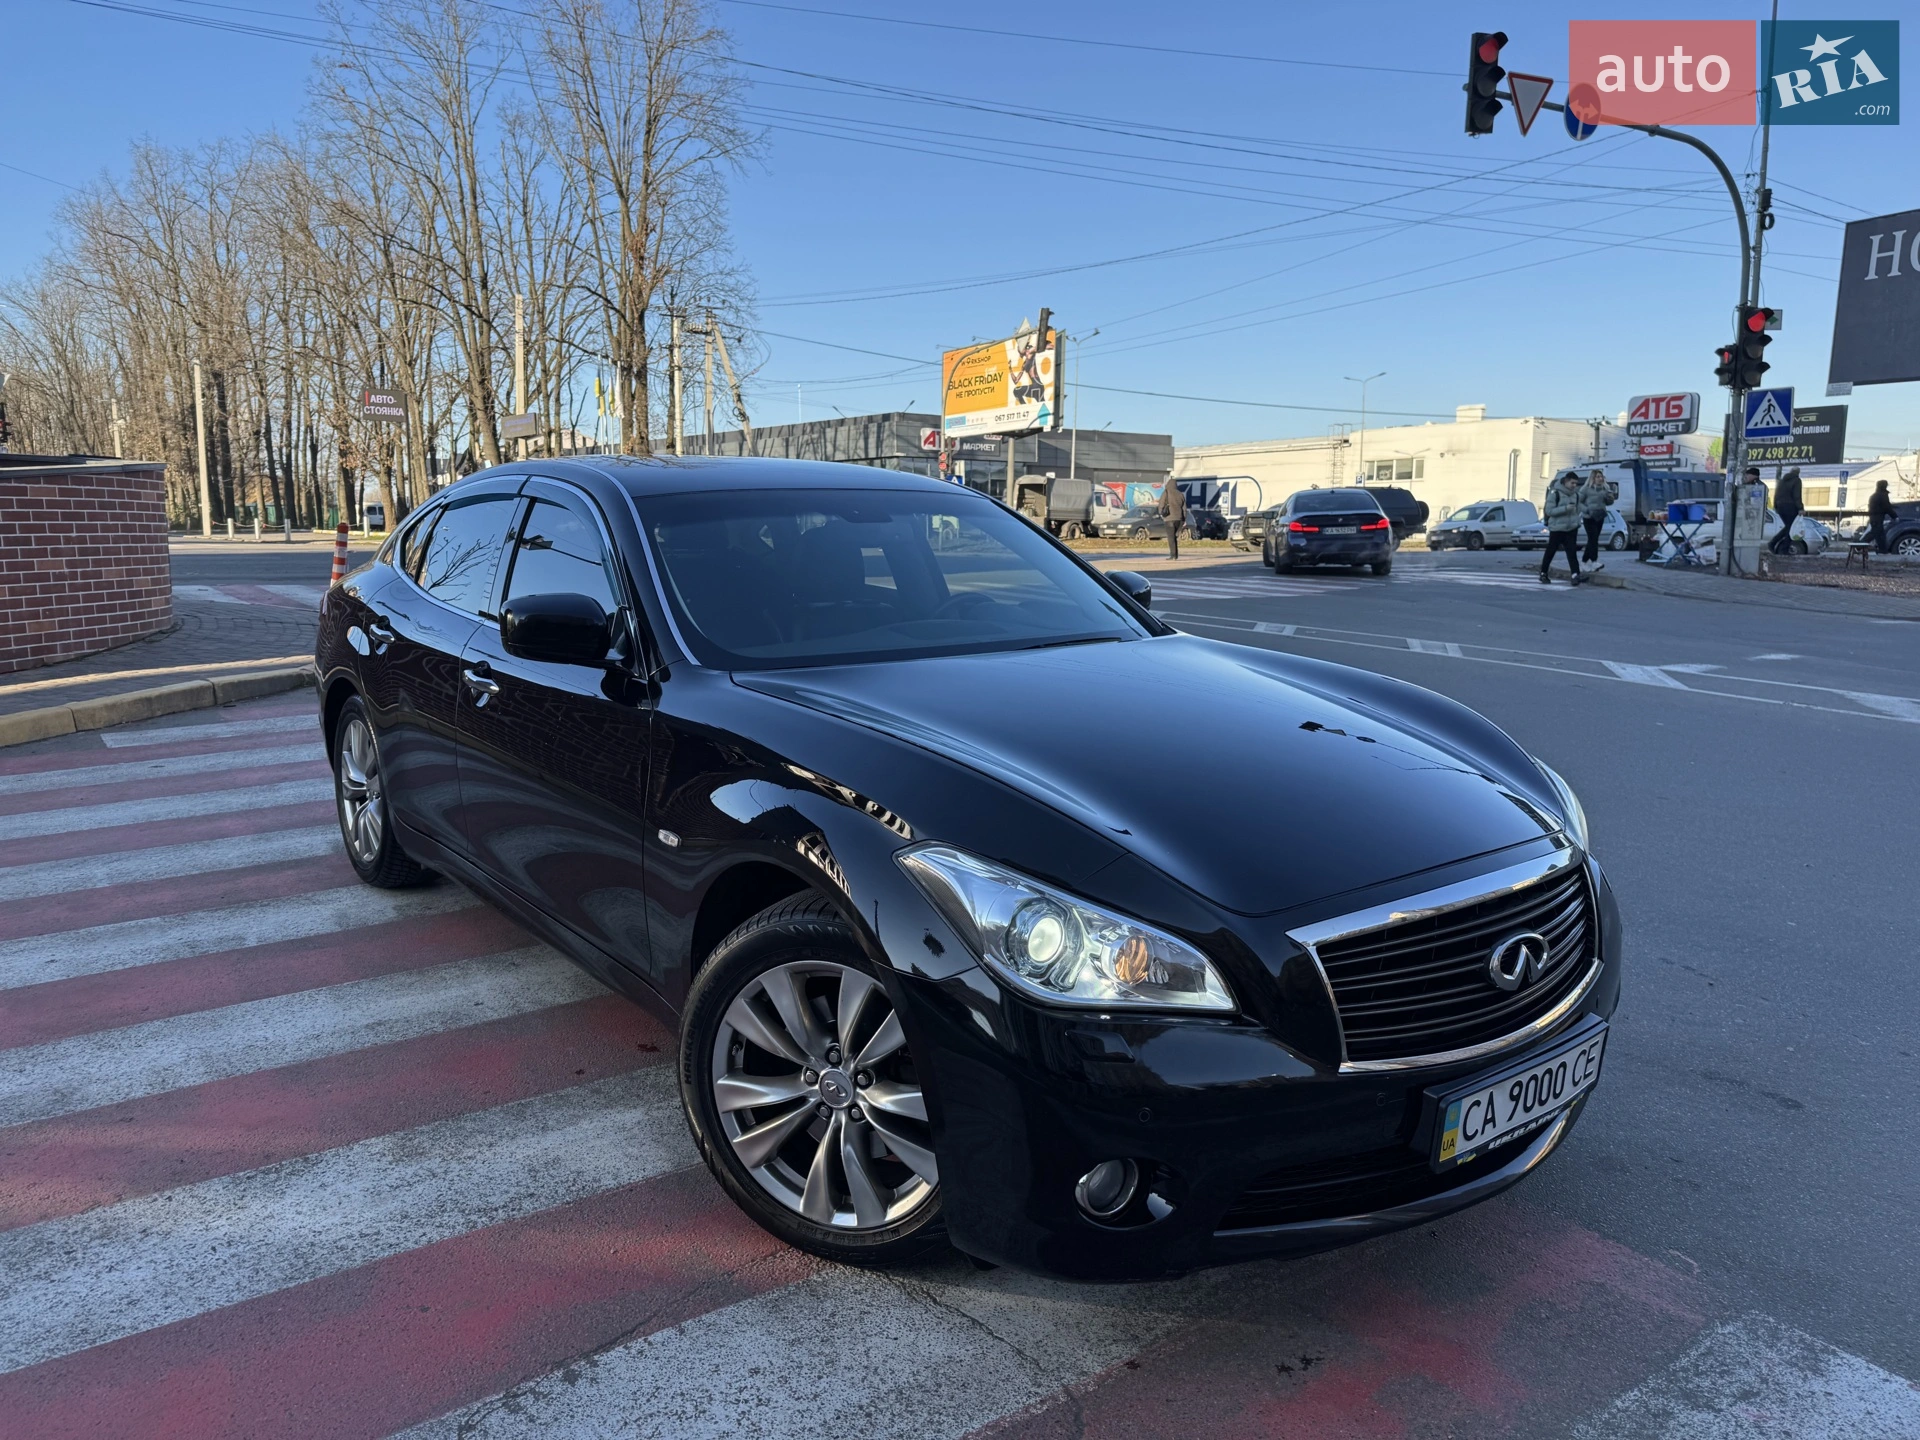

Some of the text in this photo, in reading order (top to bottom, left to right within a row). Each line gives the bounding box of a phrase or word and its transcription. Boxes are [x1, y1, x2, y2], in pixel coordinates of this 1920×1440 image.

[948, 377, 974, 390] BLACK
[955, 386, 995, 399] НЕ ПРОПУСТИ
[363, 405, 404, 417] СТОЯНКА
[1630, 395, 1687, 421] АТБ
[1630, 421, 1685, 435] МАРКЕТ
[1803, 424, 1830, 435] ПЛІВКИ
[962, 442, 996, 452] МАРКЕТ
[1644, 445, 1667, 454] 00-24
[1765, 446, 1784, 459] 498
[1786, 446, 1799, 458] 72
[1801, 445, 1813, 457] 71
[1462, 1039, 1600, 1142] CA 9000 CE
[1442, 1137, 1456, 1152] UA
